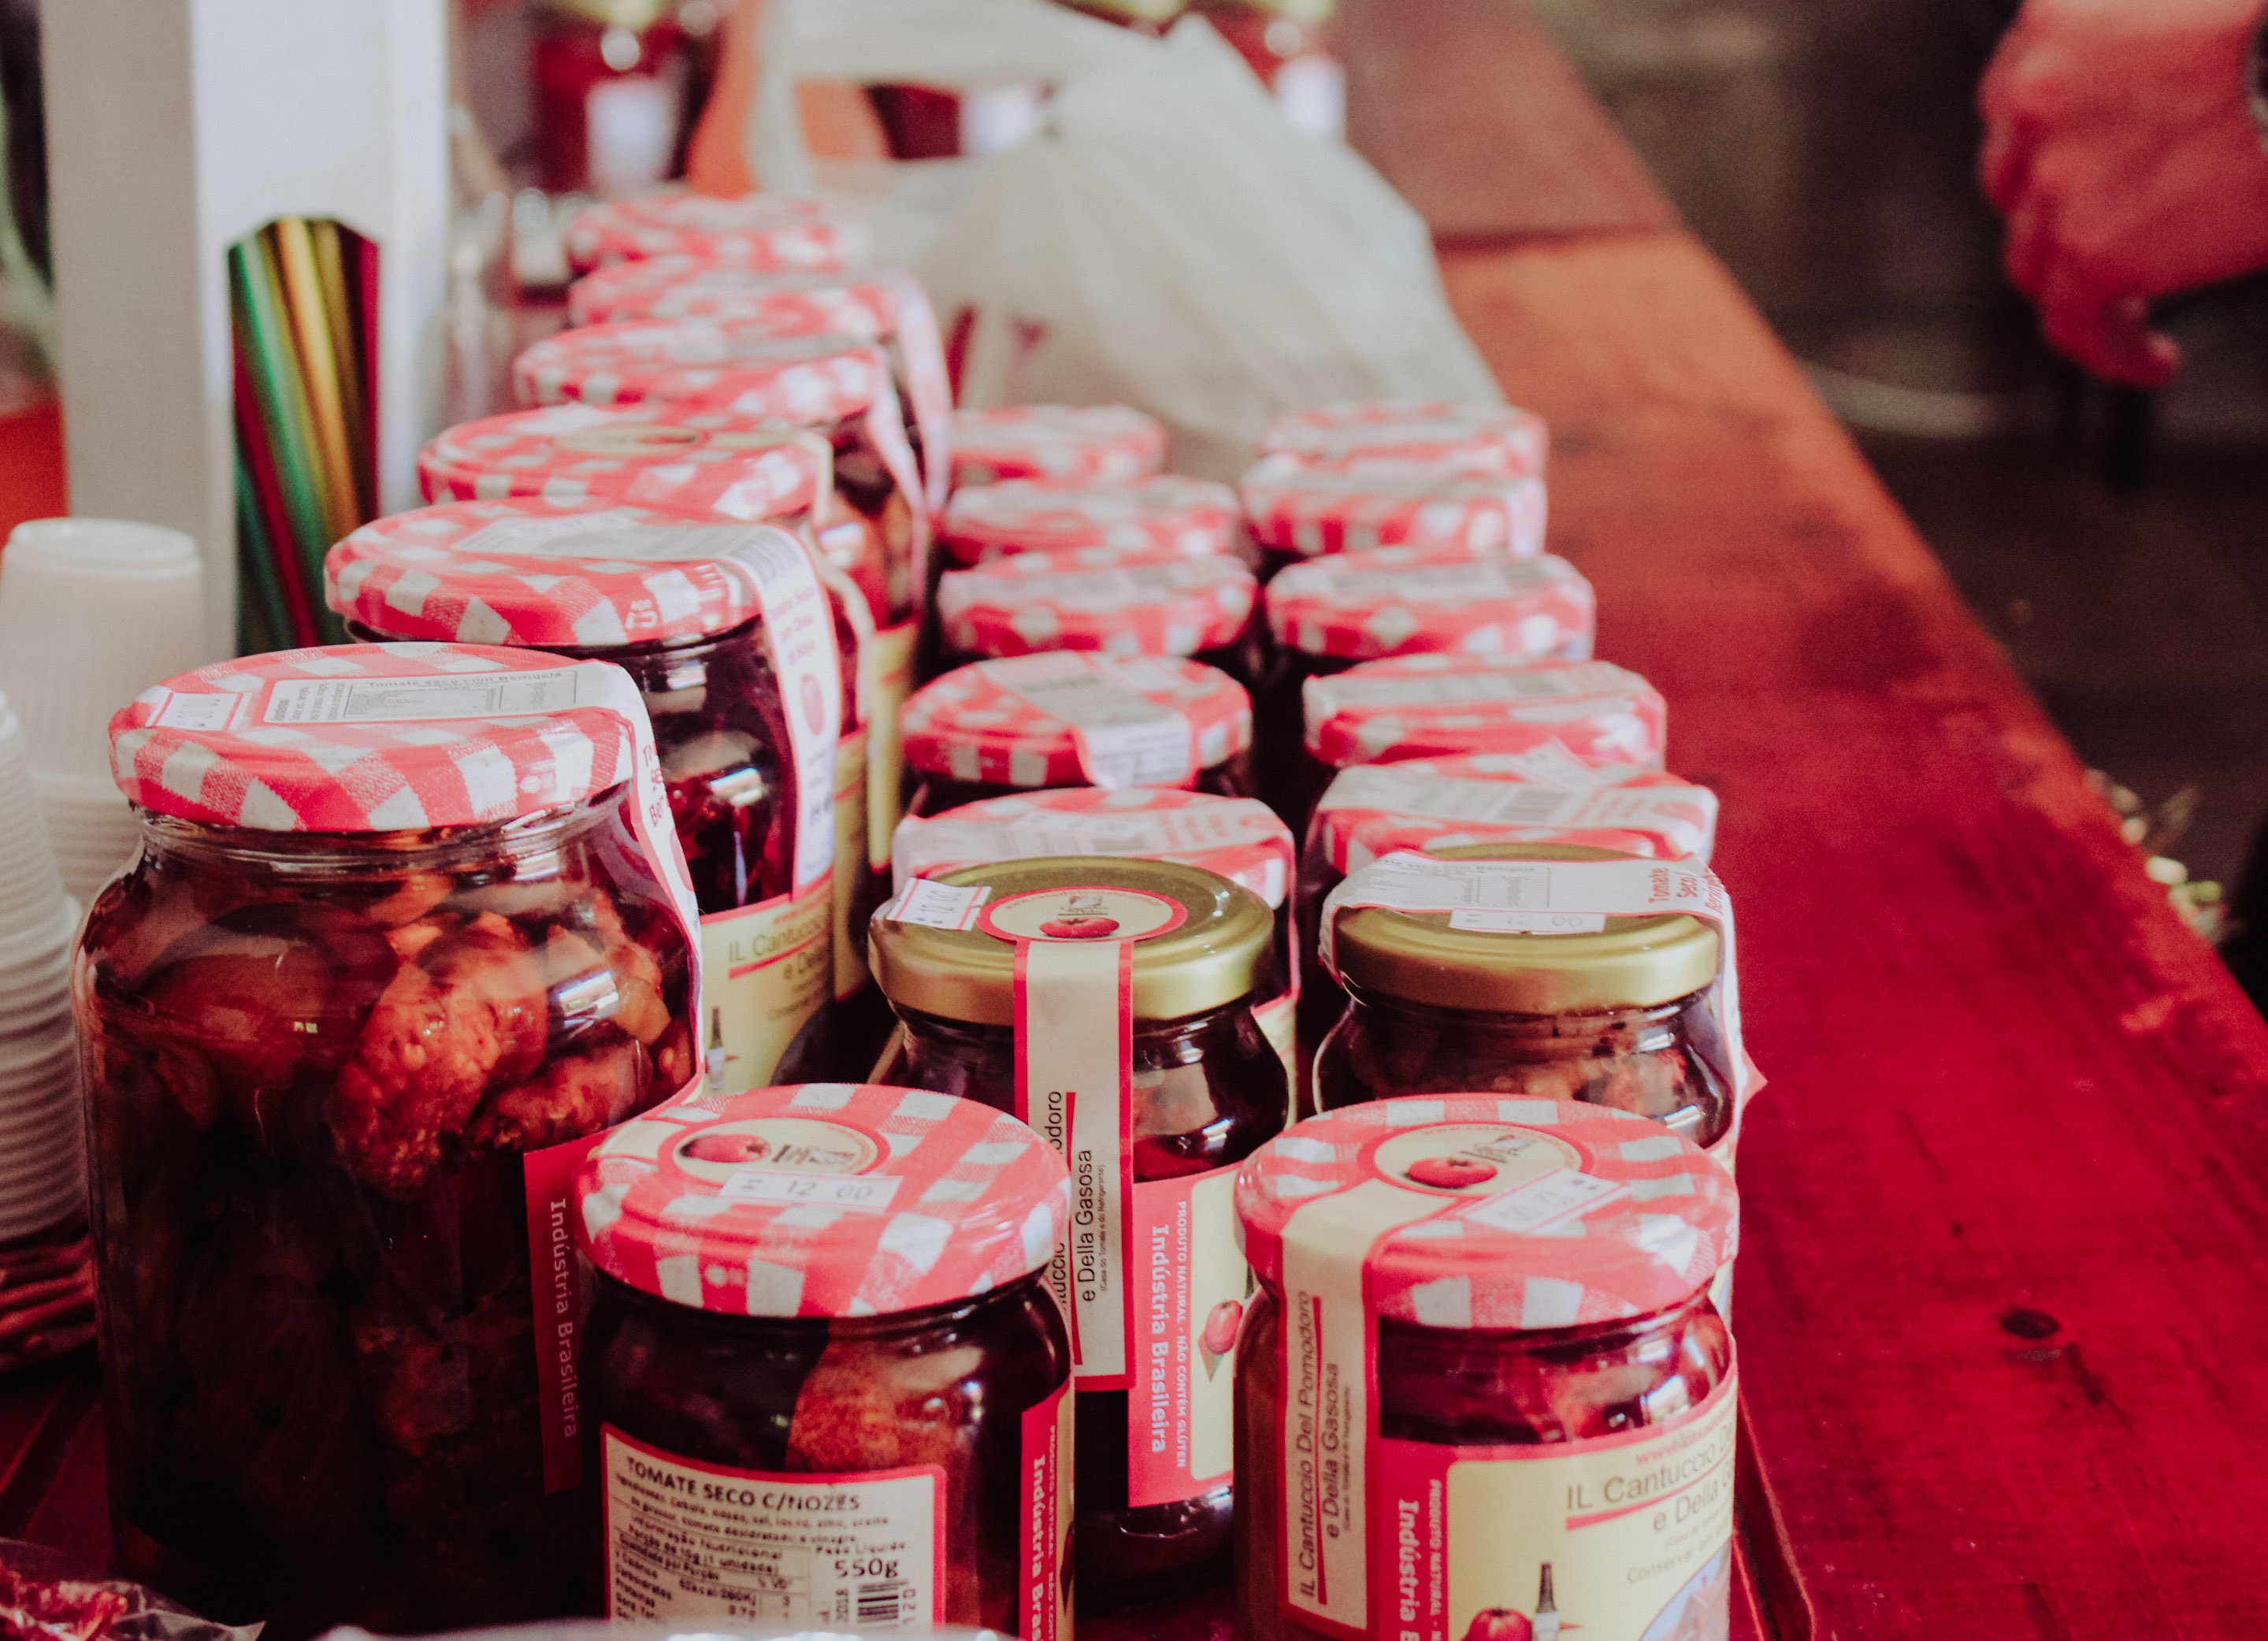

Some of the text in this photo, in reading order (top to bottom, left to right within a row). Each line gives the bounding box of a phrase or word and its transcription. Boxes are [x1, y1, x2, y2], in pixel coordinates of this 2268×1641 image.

[1648, 867, 1670, 904] Tomate
[1045, 1090, 1063, 1155] odoro
[1075, 1149, 1096, 1302] e Della Gasosa
[1177, 1201, 1187, 1262] PRODUTO
[550, 1197, 580, 1439] Indústria Brasileira
[1176, 1265, 1186, 1324] NATURAL
[1151, 1224, 1171, 1454] Indústria Brasileira
[1177, 1335, 1189, 1362] NÃO
[1176, 1364, 1189, 1417] CONTÉM
[1176, 1419, 1189, 1468] GLÚTEN
[1296, 1290, 1316, 1598] IL Cantuccio Del Pomodoro
[1320, 1362, 1340, 1539] e Della Gasosa
[1567, 1483, 1594, 1510] IL
[1603, 1442, 1716, 1504] Cantuccio
[628, 1455, 696, 1496] TOMATE
[703, 1483, 755, 1506] SECO
[1653, 1512, 1667, 1531] e
[1675, 1479, 1719, 1524] Della
[1032, 1454, 1046, 1578] Indústria
[1429, 1479, 1442, 1550] PRODUTO
[834, 1557, 898, 1579] 550g
[1398, 1498, 1422, 1622] Indústria
[1430, 1551, 1442, 1616] NATURAL
